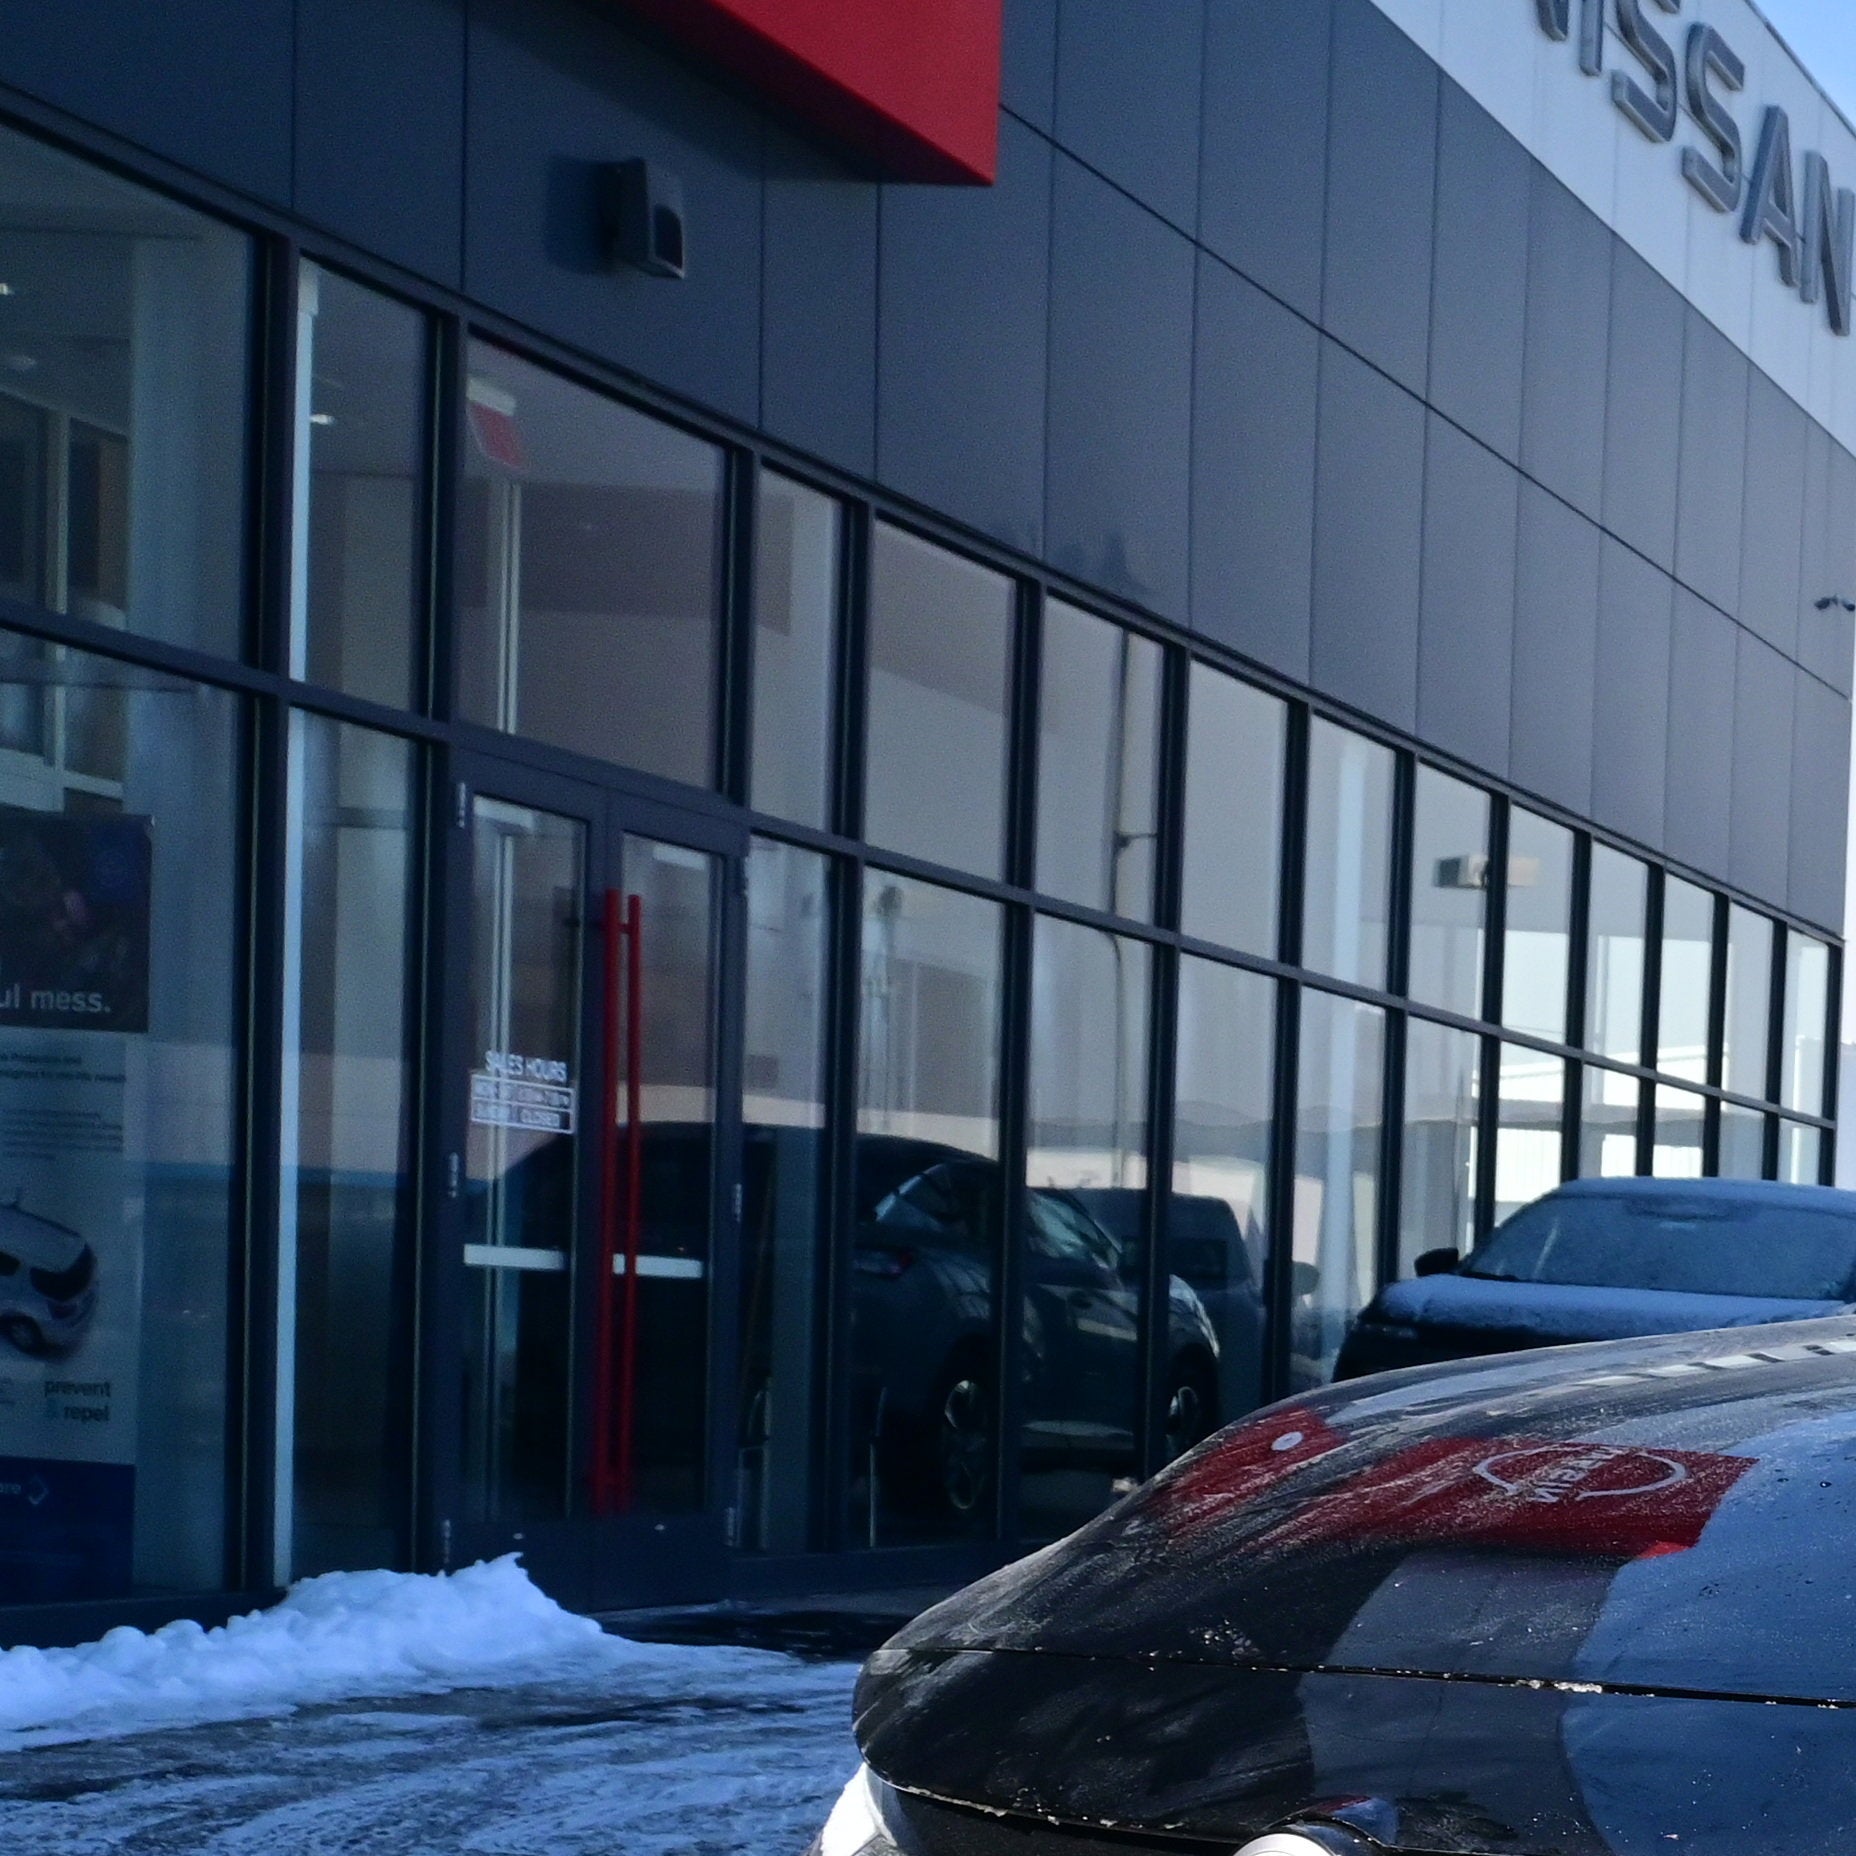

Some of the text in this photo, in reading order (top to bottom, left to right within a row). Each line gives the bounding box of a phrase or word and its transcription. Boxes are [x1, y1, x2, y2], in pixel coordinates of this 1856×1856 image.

[1536, 0, 1856, 337] SSAN
[30, 989, 112, 1013] mess.
[525, 1056, 568, 1082] HOURS
[44, 1380, 111, 1397] prevent
[63, 1405, 110, 1423] repel
